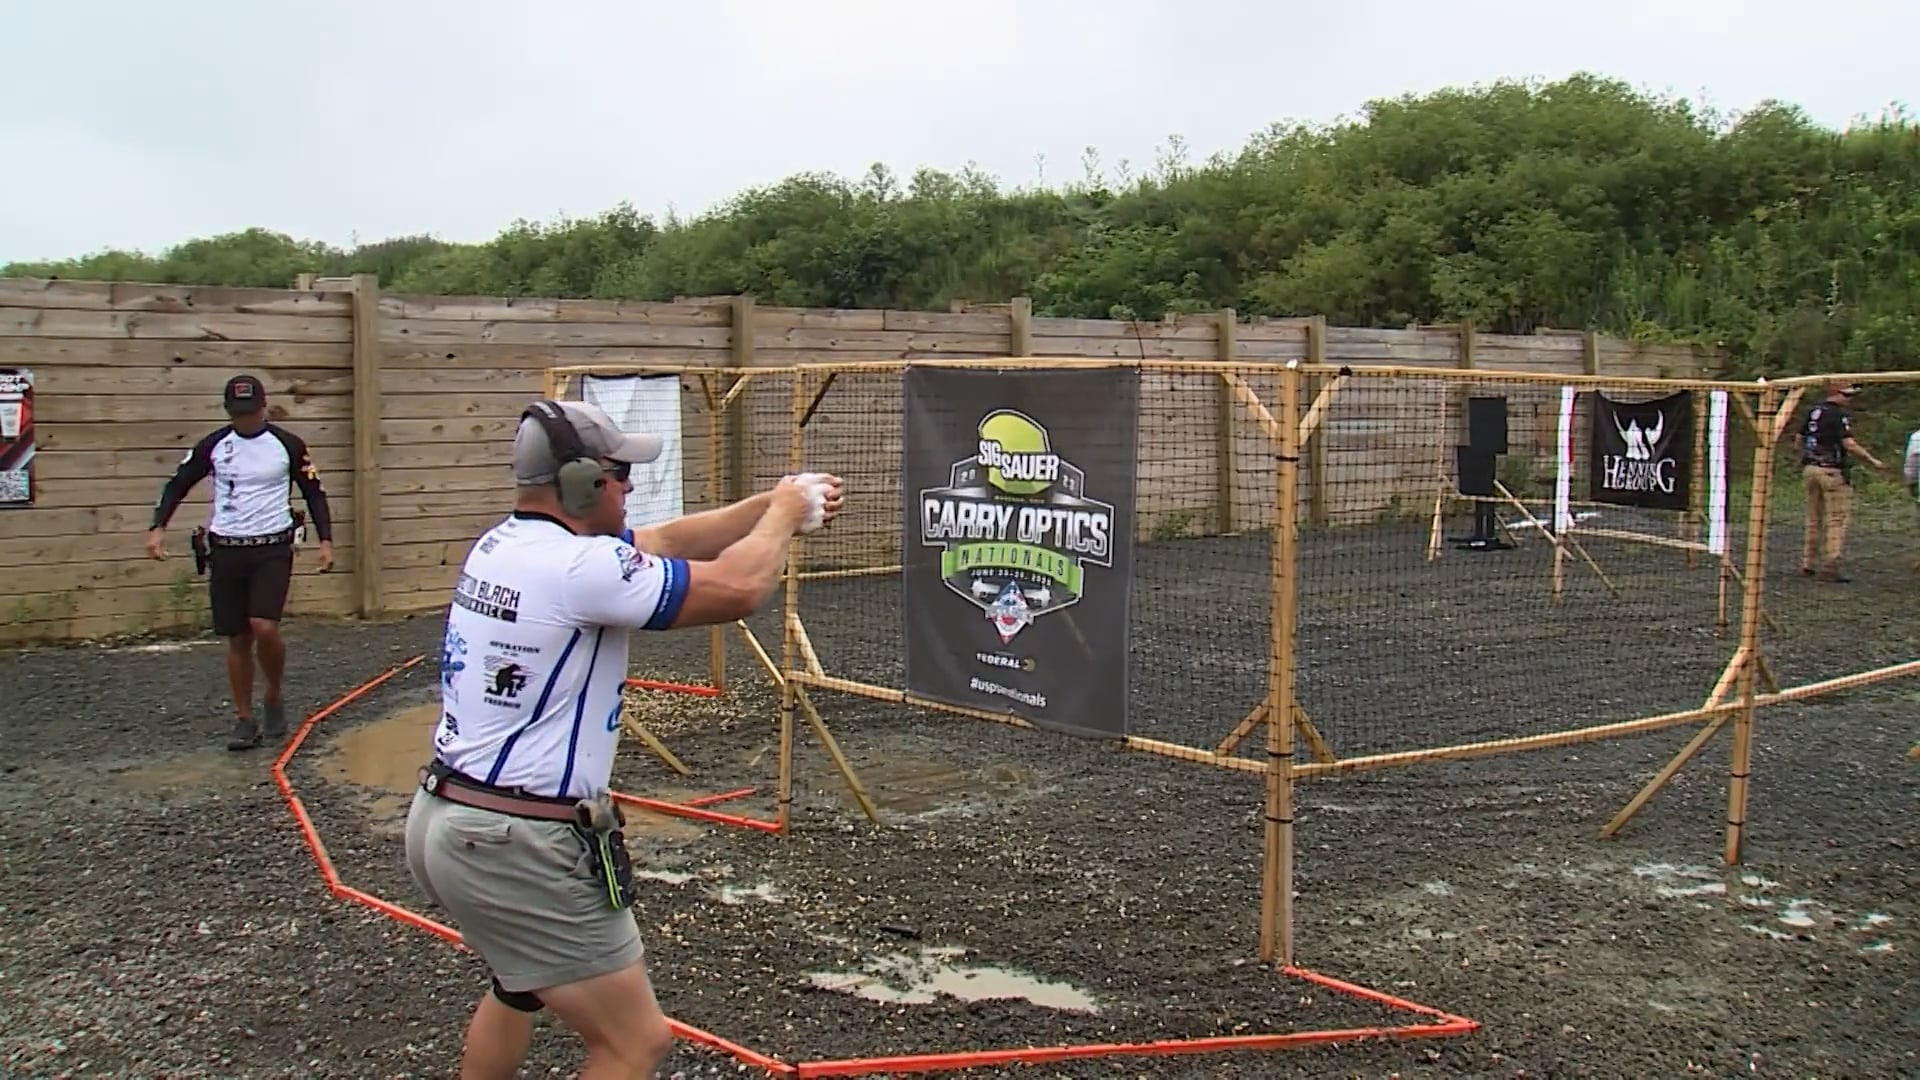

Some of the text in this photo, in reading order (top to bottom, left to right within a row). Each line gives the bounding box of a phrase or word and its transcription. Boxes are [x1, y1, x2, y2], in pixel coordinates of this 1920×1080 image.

[978, 440, 1059, 480] SIG SAUER
[924, 498, 1108, 557] CARRY OPTICS
[961, 547, 1065, 577] NATIONALS
[971, 568, 994, 577] JUNE
[976, 652, 1020, 669] FEDERAL
